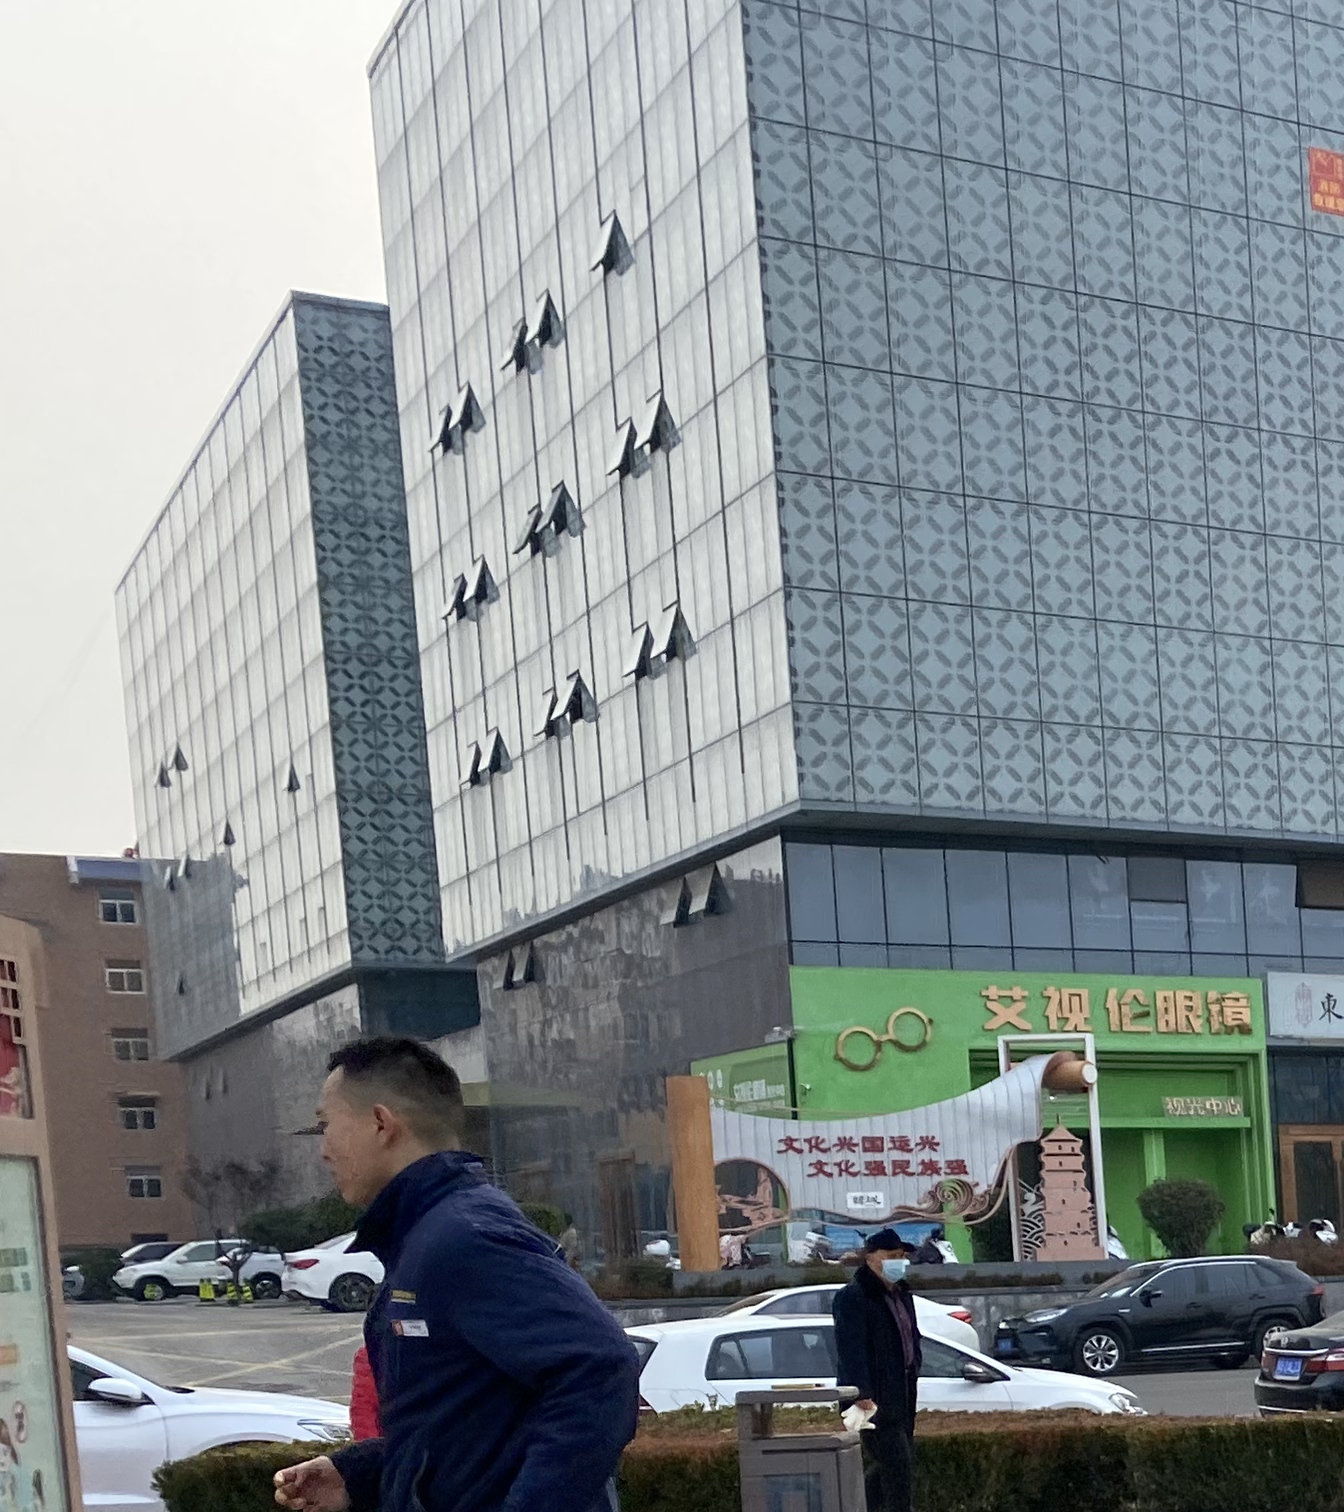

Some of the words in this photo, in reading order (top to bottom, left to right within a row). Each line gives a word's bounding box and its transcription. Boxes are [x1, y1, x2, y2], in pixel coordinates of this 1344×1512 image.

[981, 985, 1253, 1035] 艾视伦眼镜
[1166, 1097, 1242, 1117] 视光中心
[777, 1135, 941, 1155] 文化兴国运兴
[806, 1158, 970, 1178] 文化强民族强
